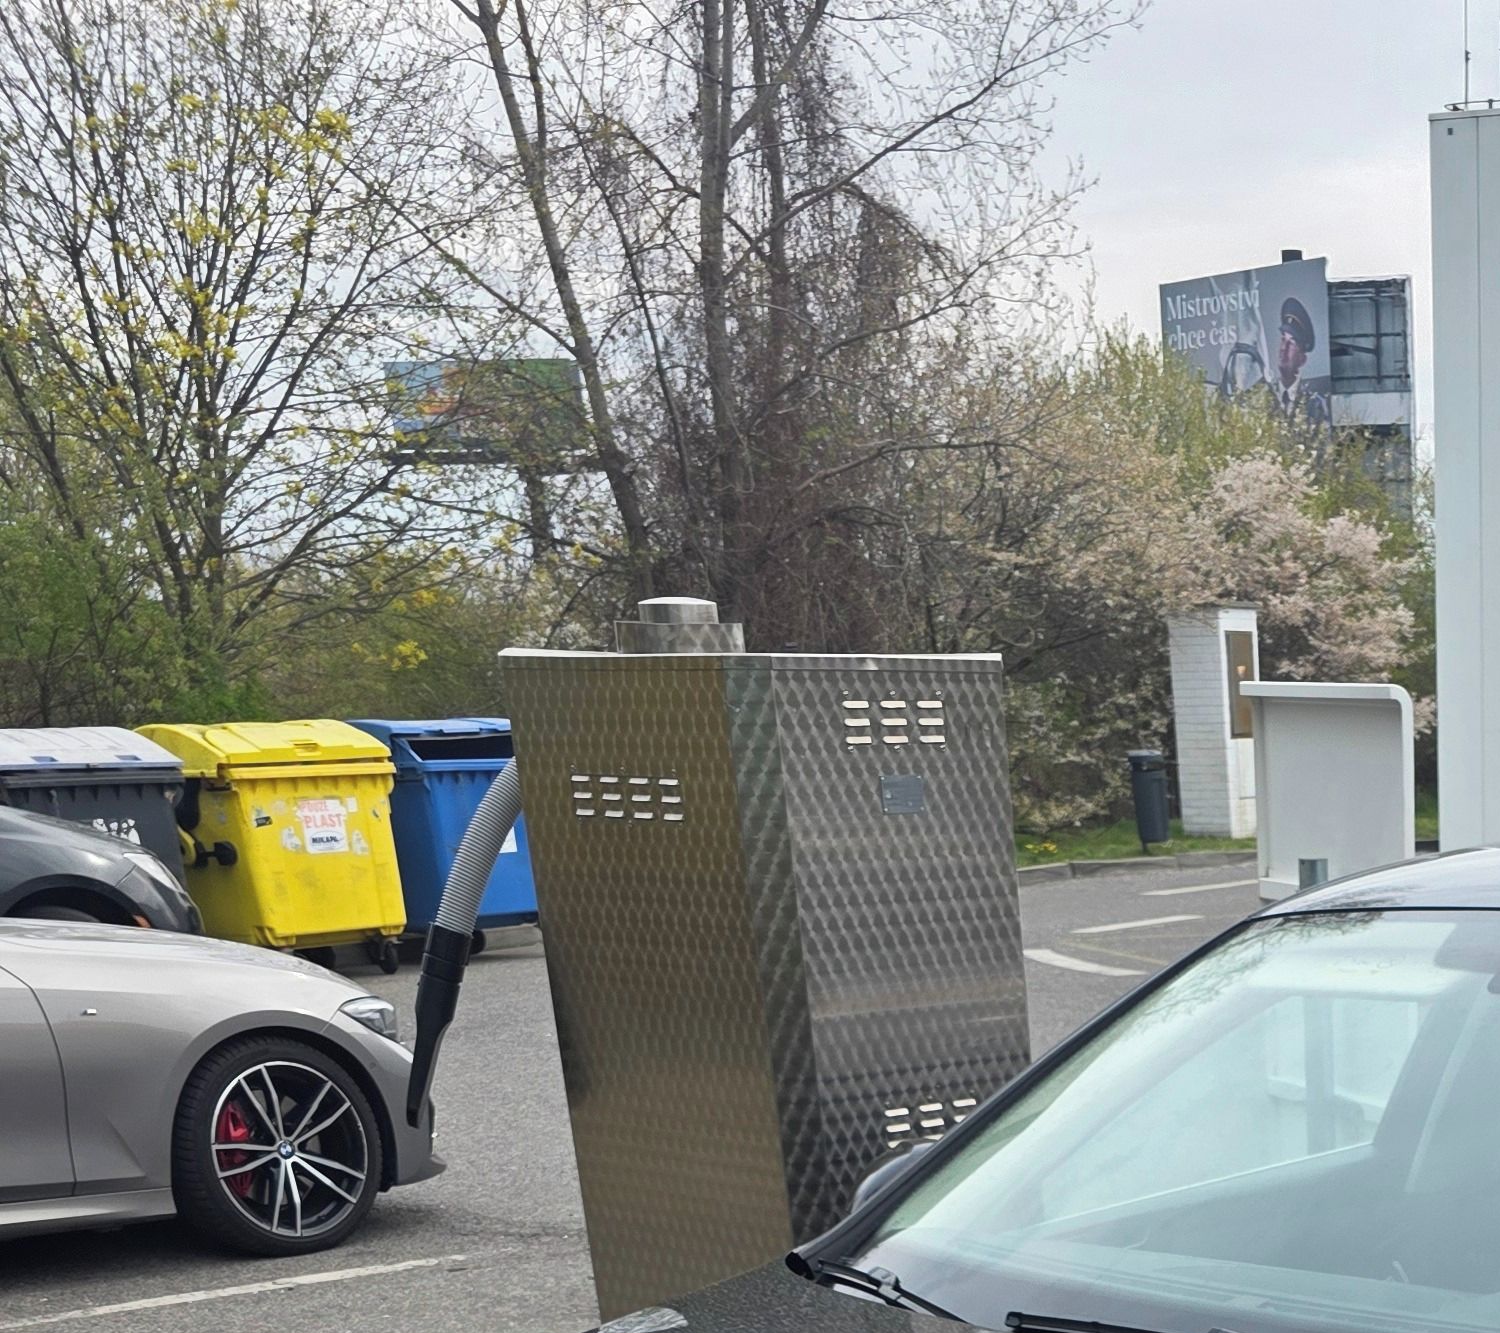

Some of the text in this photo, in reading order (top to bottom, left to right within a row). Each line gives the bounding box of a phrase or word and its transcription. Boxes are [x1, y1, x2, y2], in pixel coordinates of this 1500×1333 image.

[1166, 281, 1260, 322] Mistrovství
[1168, 319, 1238, 351] chce čas
[303, 813, 345, 828] PLAST
